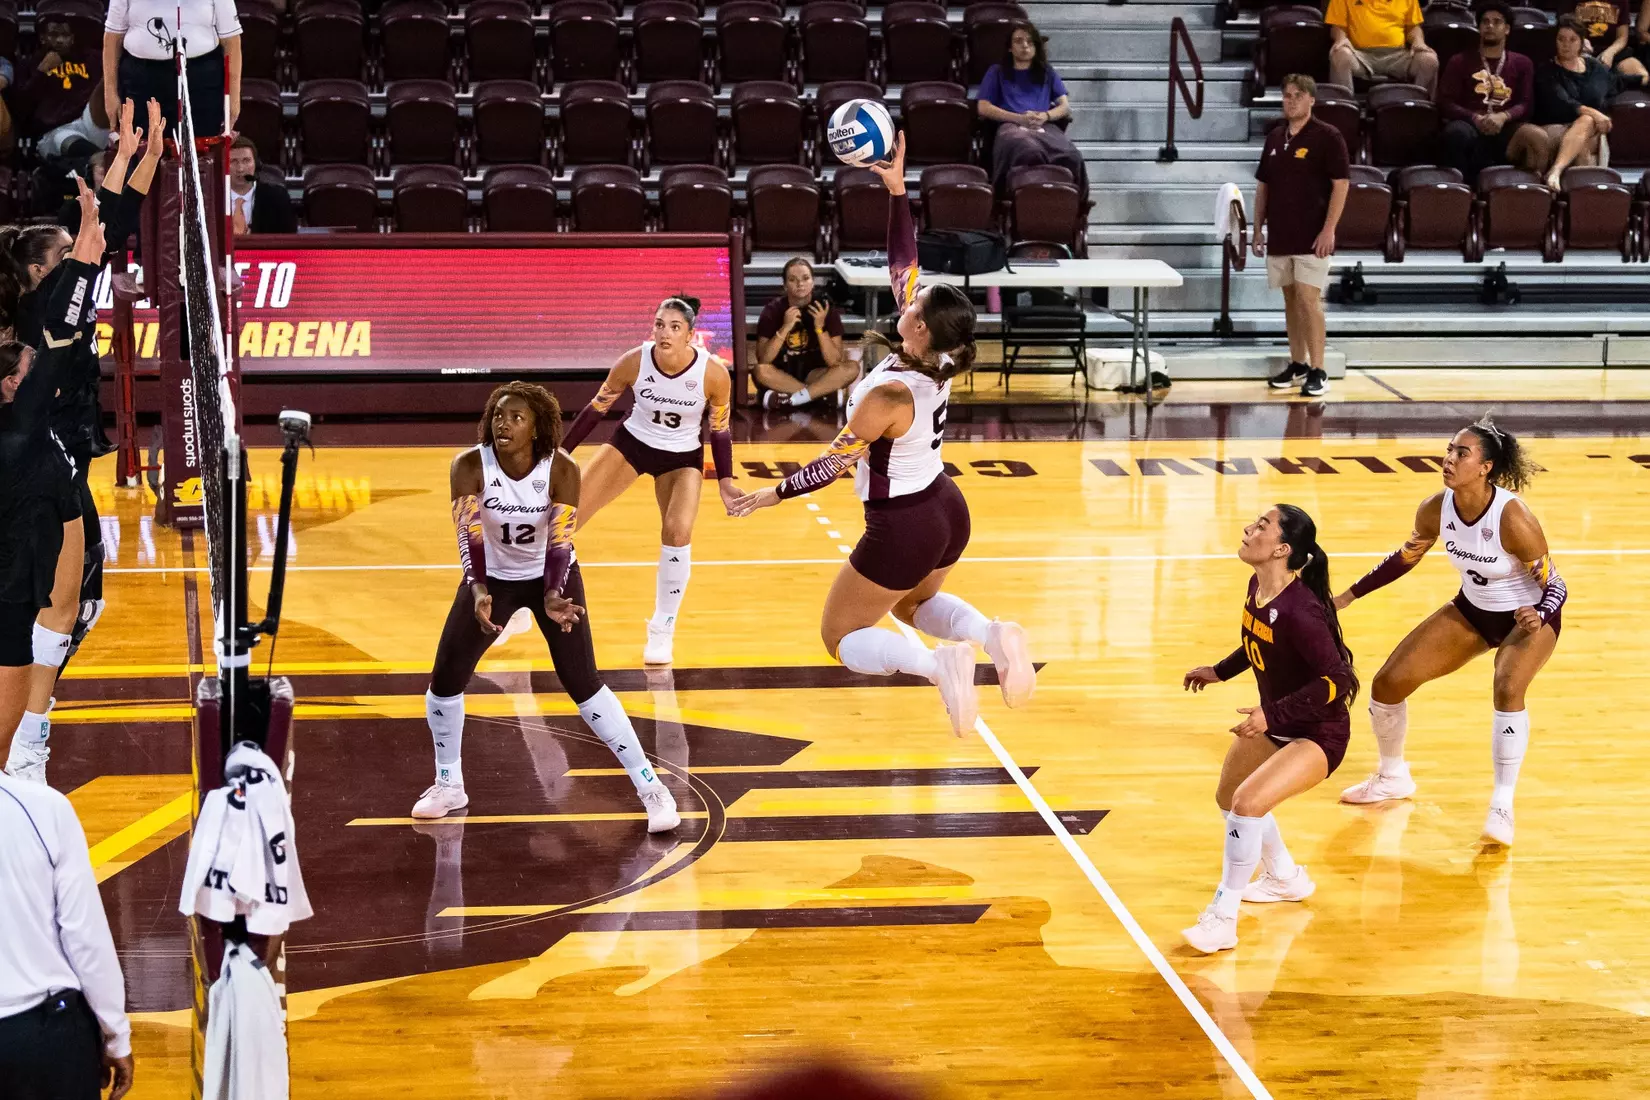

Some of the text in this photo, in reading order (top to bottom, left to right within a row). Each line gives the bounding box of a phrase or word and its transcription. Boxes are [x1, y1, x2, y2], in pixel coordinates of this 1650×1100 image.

[64, 276, 88, 326] GOLDEN
[254, 262, 297, 309] TO
[239, 321, 371, 358] ARENA
[640, 388, 697, 407] Chippewas
[180, 378, 196, 468] sports imports
[652, 410, 682, 429] 13
[500, 522, 536, 545] 12
[1445, 540, 1499, 563] Chippewas
[1243, 635, 1266, 672] 10
